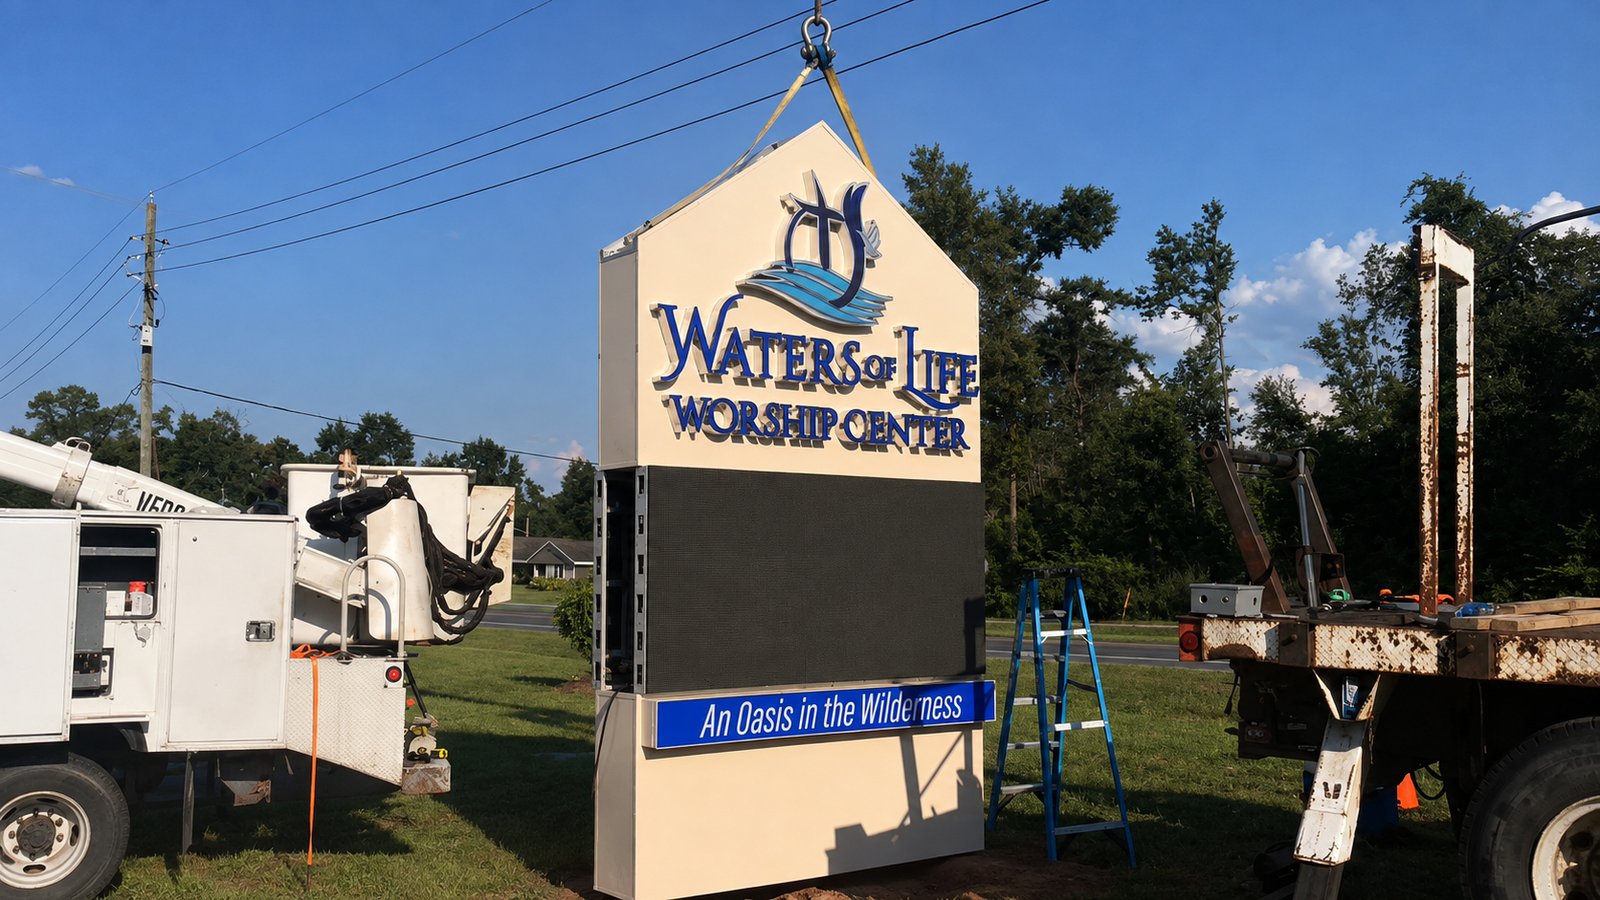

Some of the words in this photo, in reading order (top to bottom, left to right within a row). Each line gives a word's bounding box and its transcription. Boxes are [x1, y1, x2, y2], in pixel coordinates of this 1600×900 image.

[660, 294, 861, 385] WATERS
[864, 354, 897, 381] OF
[901, 326, 980, 411] LIFE
[669, 395, 838, 441] WORSHIP
[843, 408, 971, 450] CENTER
[699, 703, 731, 738] An
[736, 699, 793, 735] Oasis
[798, 696, 817, 730] in
[823, 694, 855, 727] the
[861, 690, 963, 725] Wilderness
